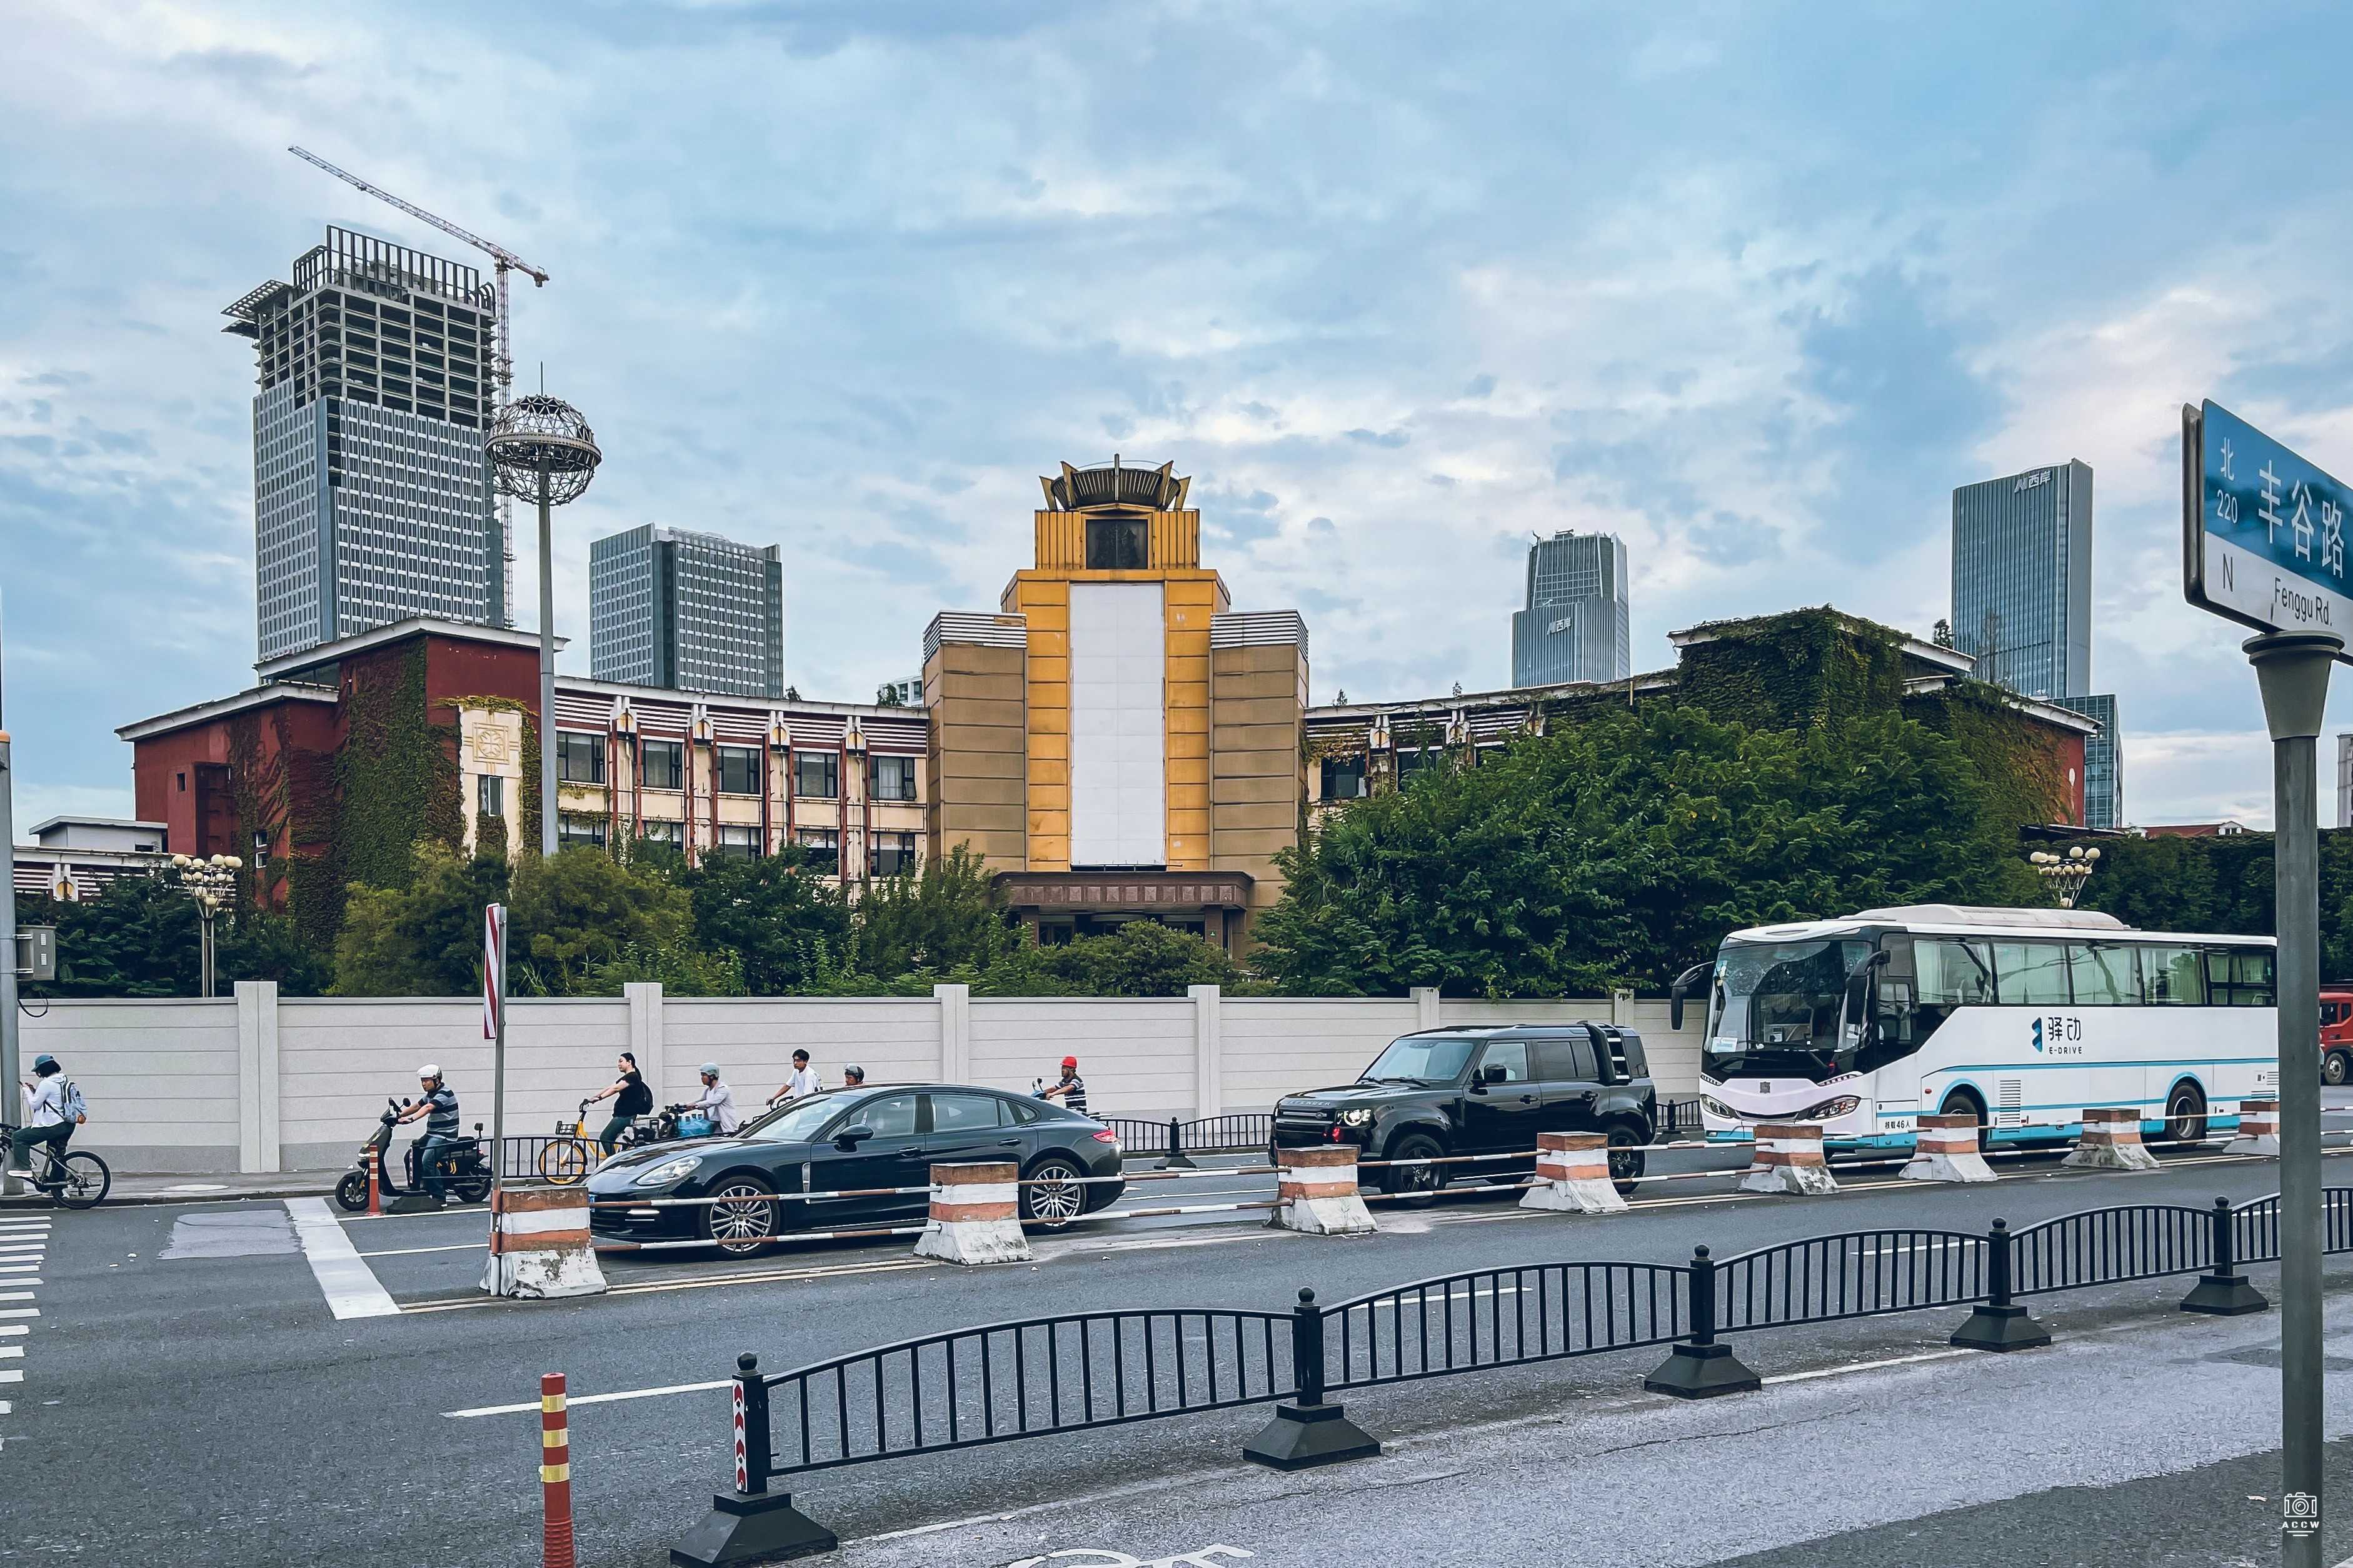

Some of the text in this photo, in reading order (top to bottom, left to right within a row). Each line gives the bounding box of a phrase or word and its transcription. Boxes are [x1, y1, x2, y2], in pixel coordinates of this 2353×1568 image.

[2220, 437, 2235, 481] 北
[2217, 489, 2238, 525] 220
[2258, 459, 2345, 579] 丰谷路
[2222, 553, 2234, 592] N
[2274, 576, 2333, 627] Fenggu Rd.
[2048, 1017, 2081, 1041] 驿动
[2049, 1046, 2082, 1054] E-DRIVE
